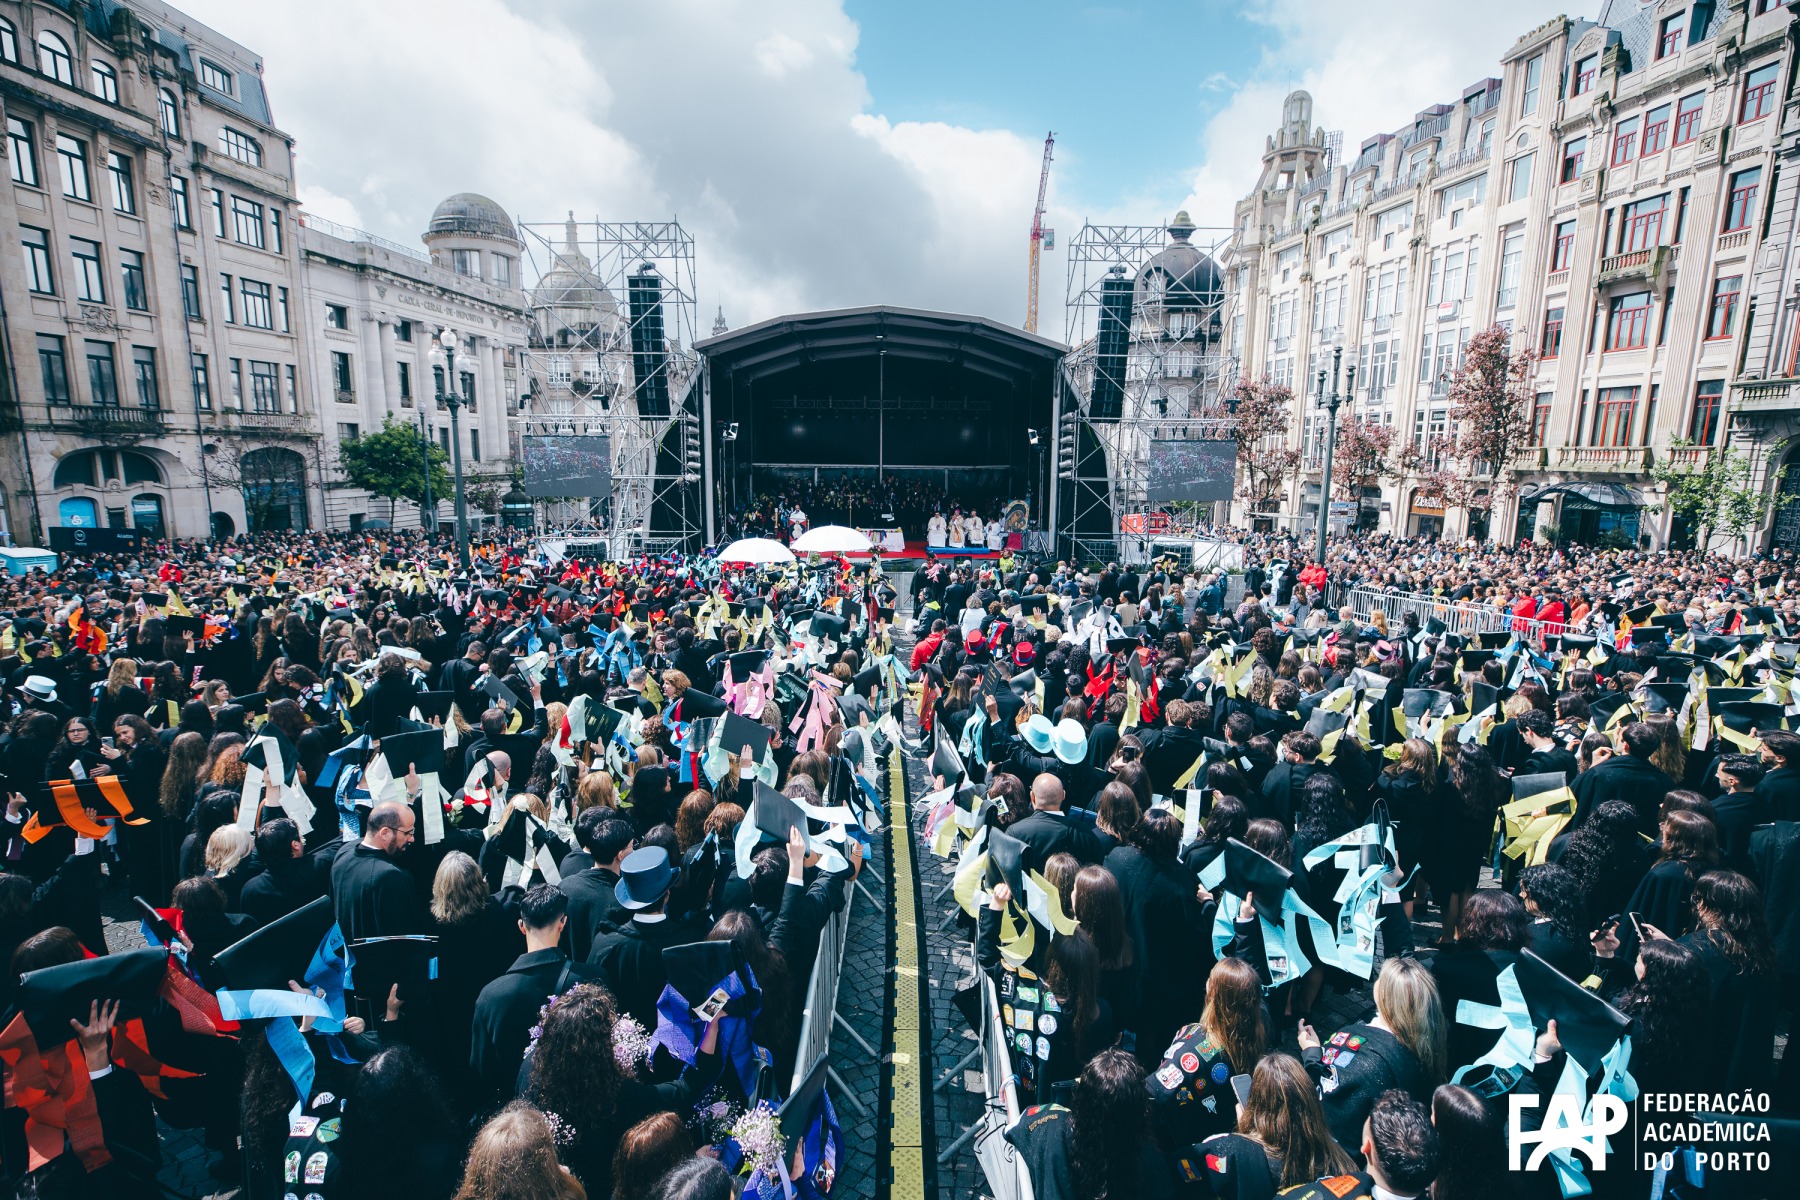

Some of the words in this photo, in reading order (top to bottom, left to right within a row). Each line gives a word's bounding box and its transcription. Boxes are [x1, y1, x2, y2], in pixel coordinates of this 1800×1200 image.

[398, 294, 420, 307] CAIXA
[424, 301, 443, 313] GERAL
[446, 306, 453, 316] DE
